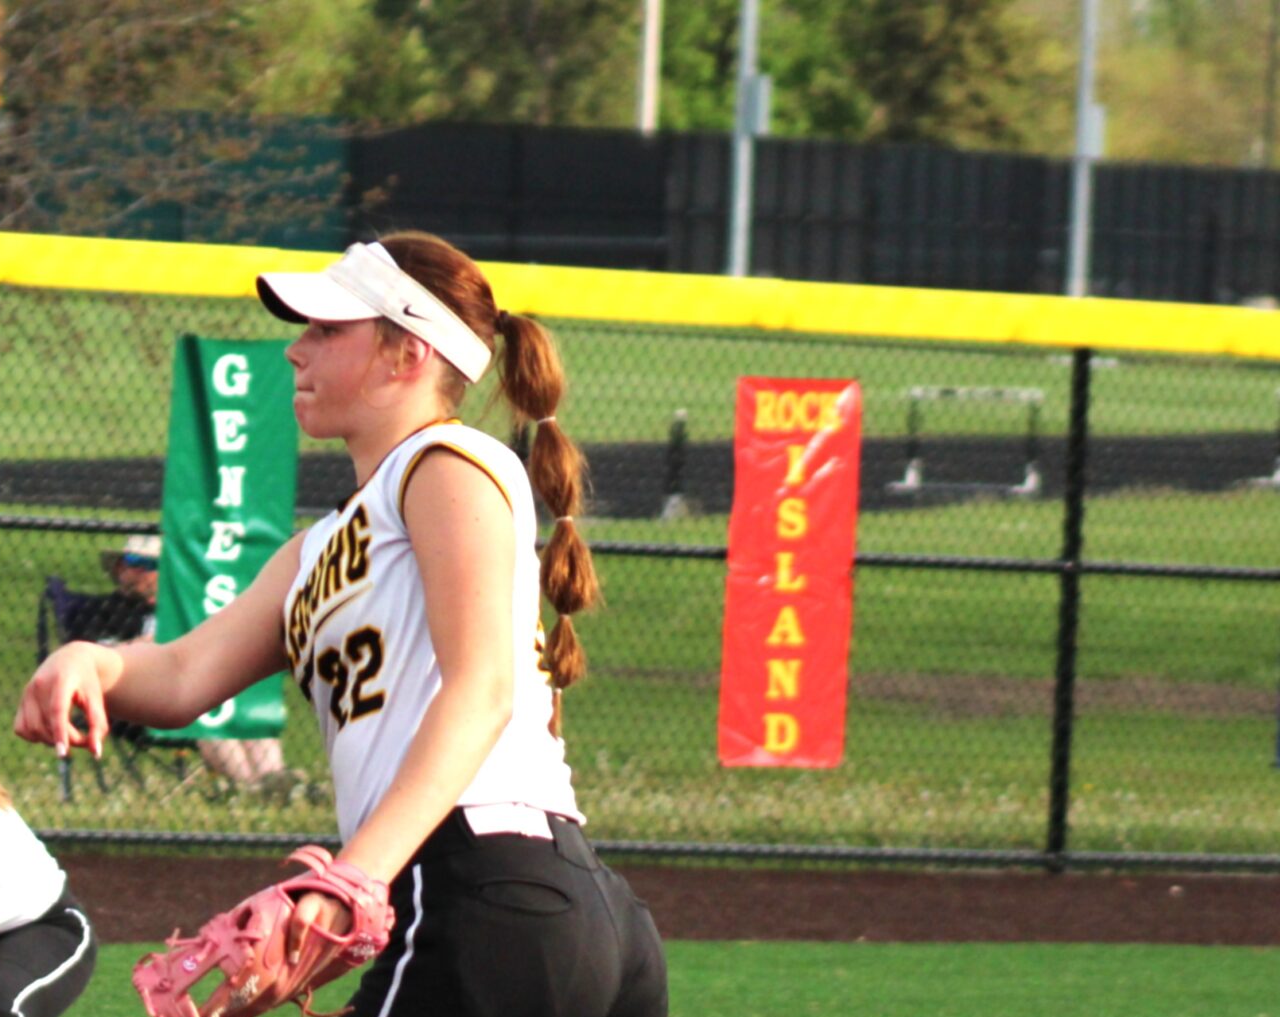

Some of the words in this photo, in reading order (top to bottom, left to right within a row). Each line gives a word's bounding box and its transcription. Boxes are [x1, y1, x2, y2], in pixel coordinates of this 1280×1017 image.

[754, 390, 843, 432] ROCK
[197, 353, 252, 727] GENES
[762, 444, 809, 754] ISLAND
[317, 624, 387, 732] 22
